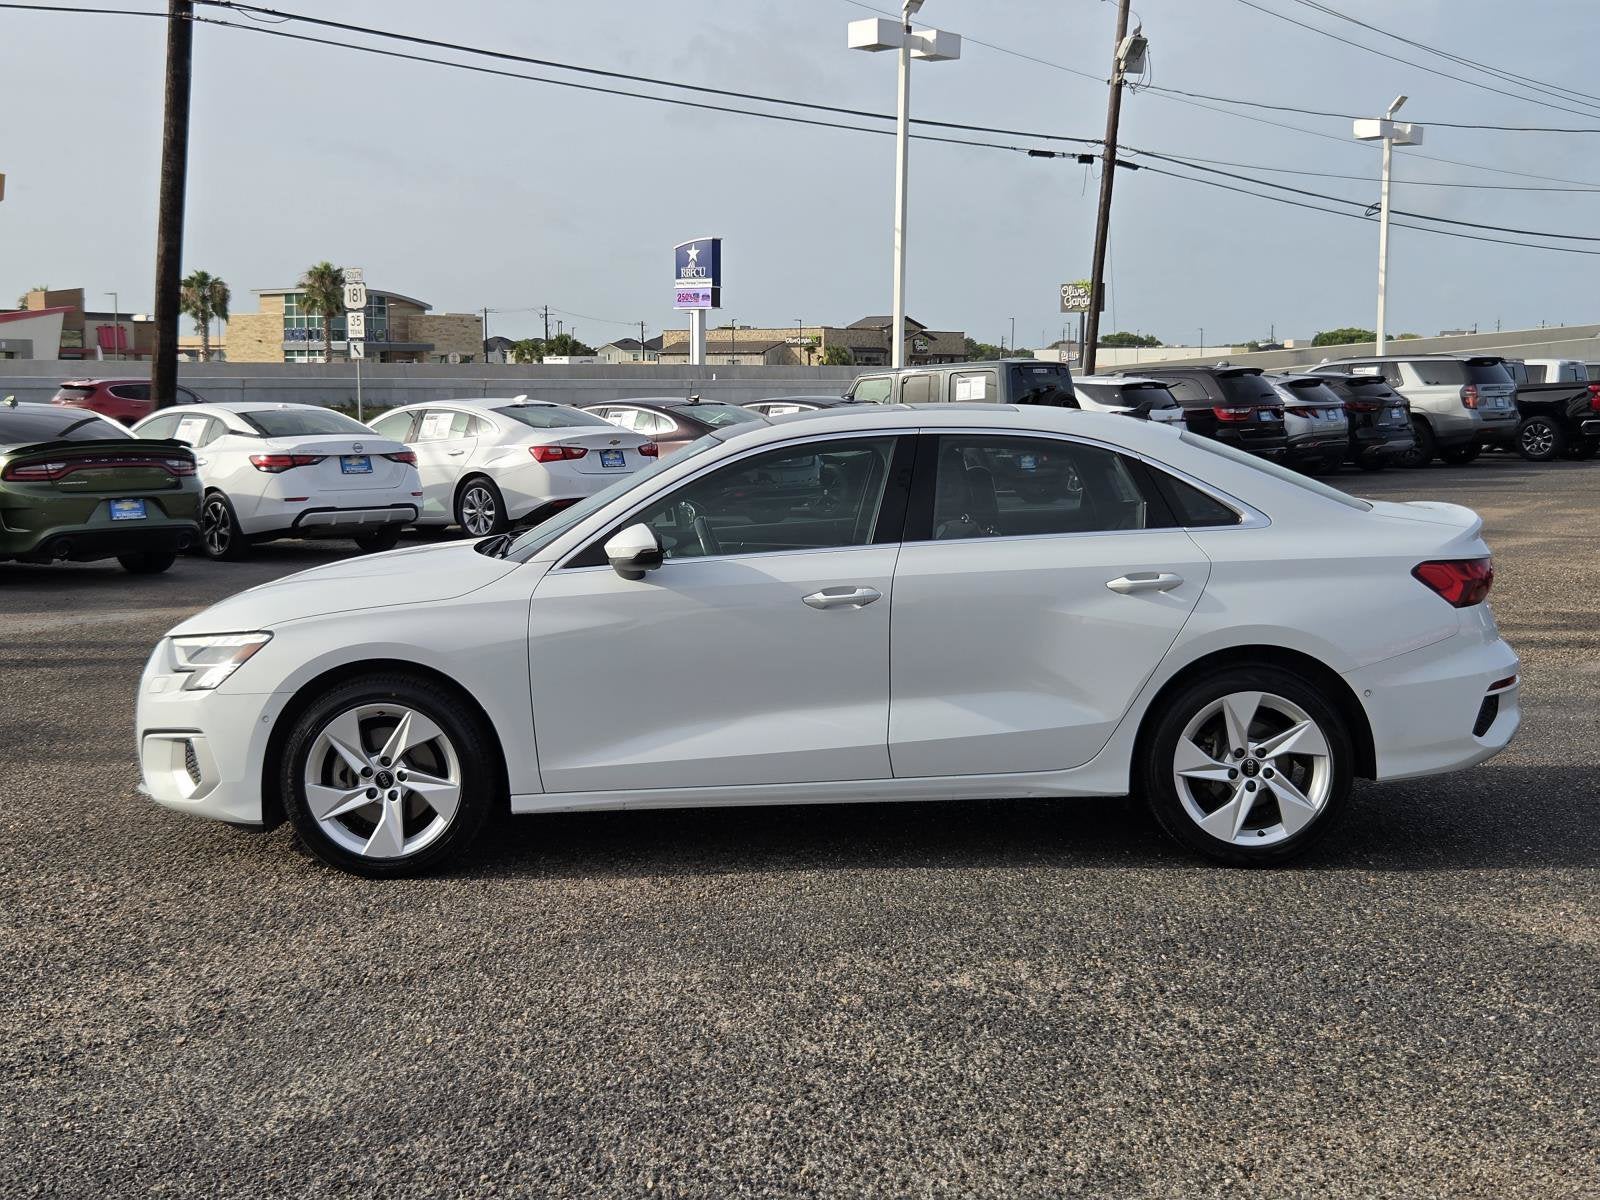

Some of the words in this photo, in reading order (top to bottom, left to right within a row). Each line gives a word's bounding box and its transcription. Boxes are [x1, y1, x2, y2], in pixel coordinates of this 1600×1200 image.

[348, 288, 362, 302] 181
[1060, 285, 1086, 297] Olive
[350, 315, 362, 327] 35
